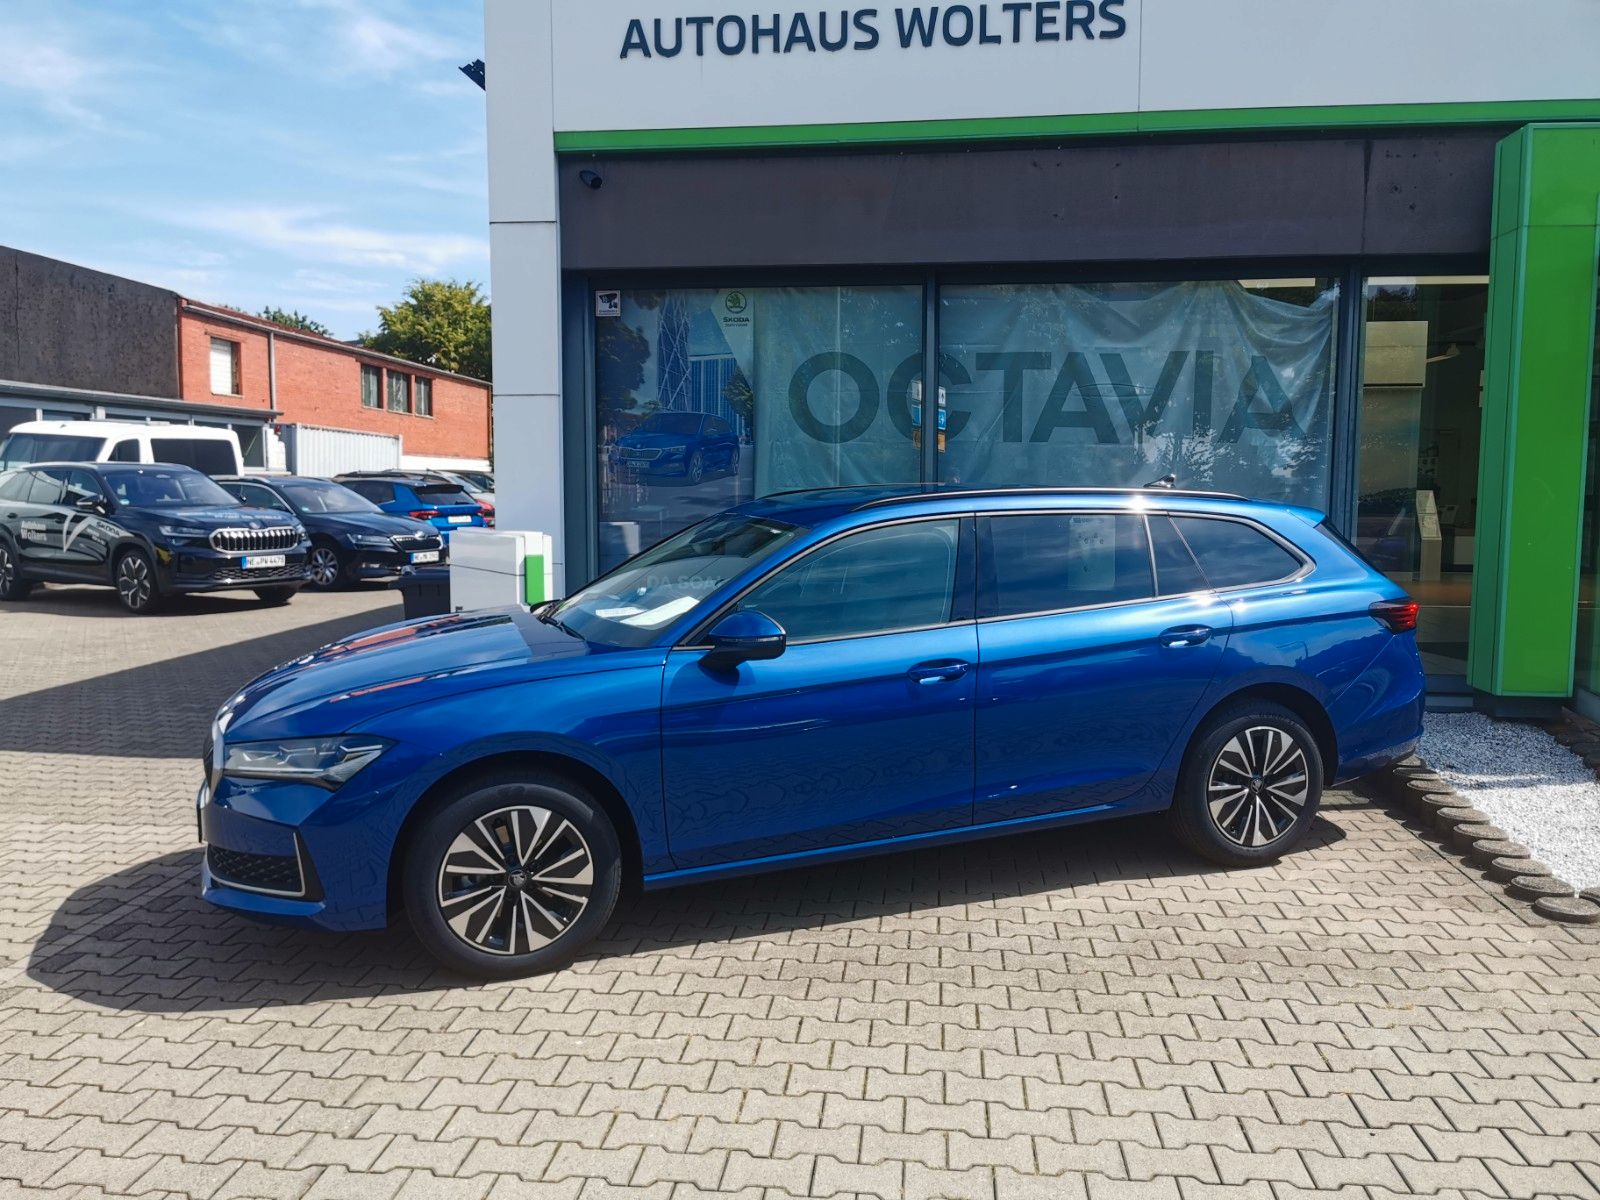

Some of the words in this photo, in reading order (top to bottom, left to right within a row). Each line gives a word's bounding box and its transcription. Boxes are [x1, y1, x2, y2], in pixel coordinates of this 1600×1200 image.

[620, 8, 880, 59] AUTOHAUS
[895, 0, 1127, 48] WOLTERS
[788, 350, 1309, 444] OCTAVIA
